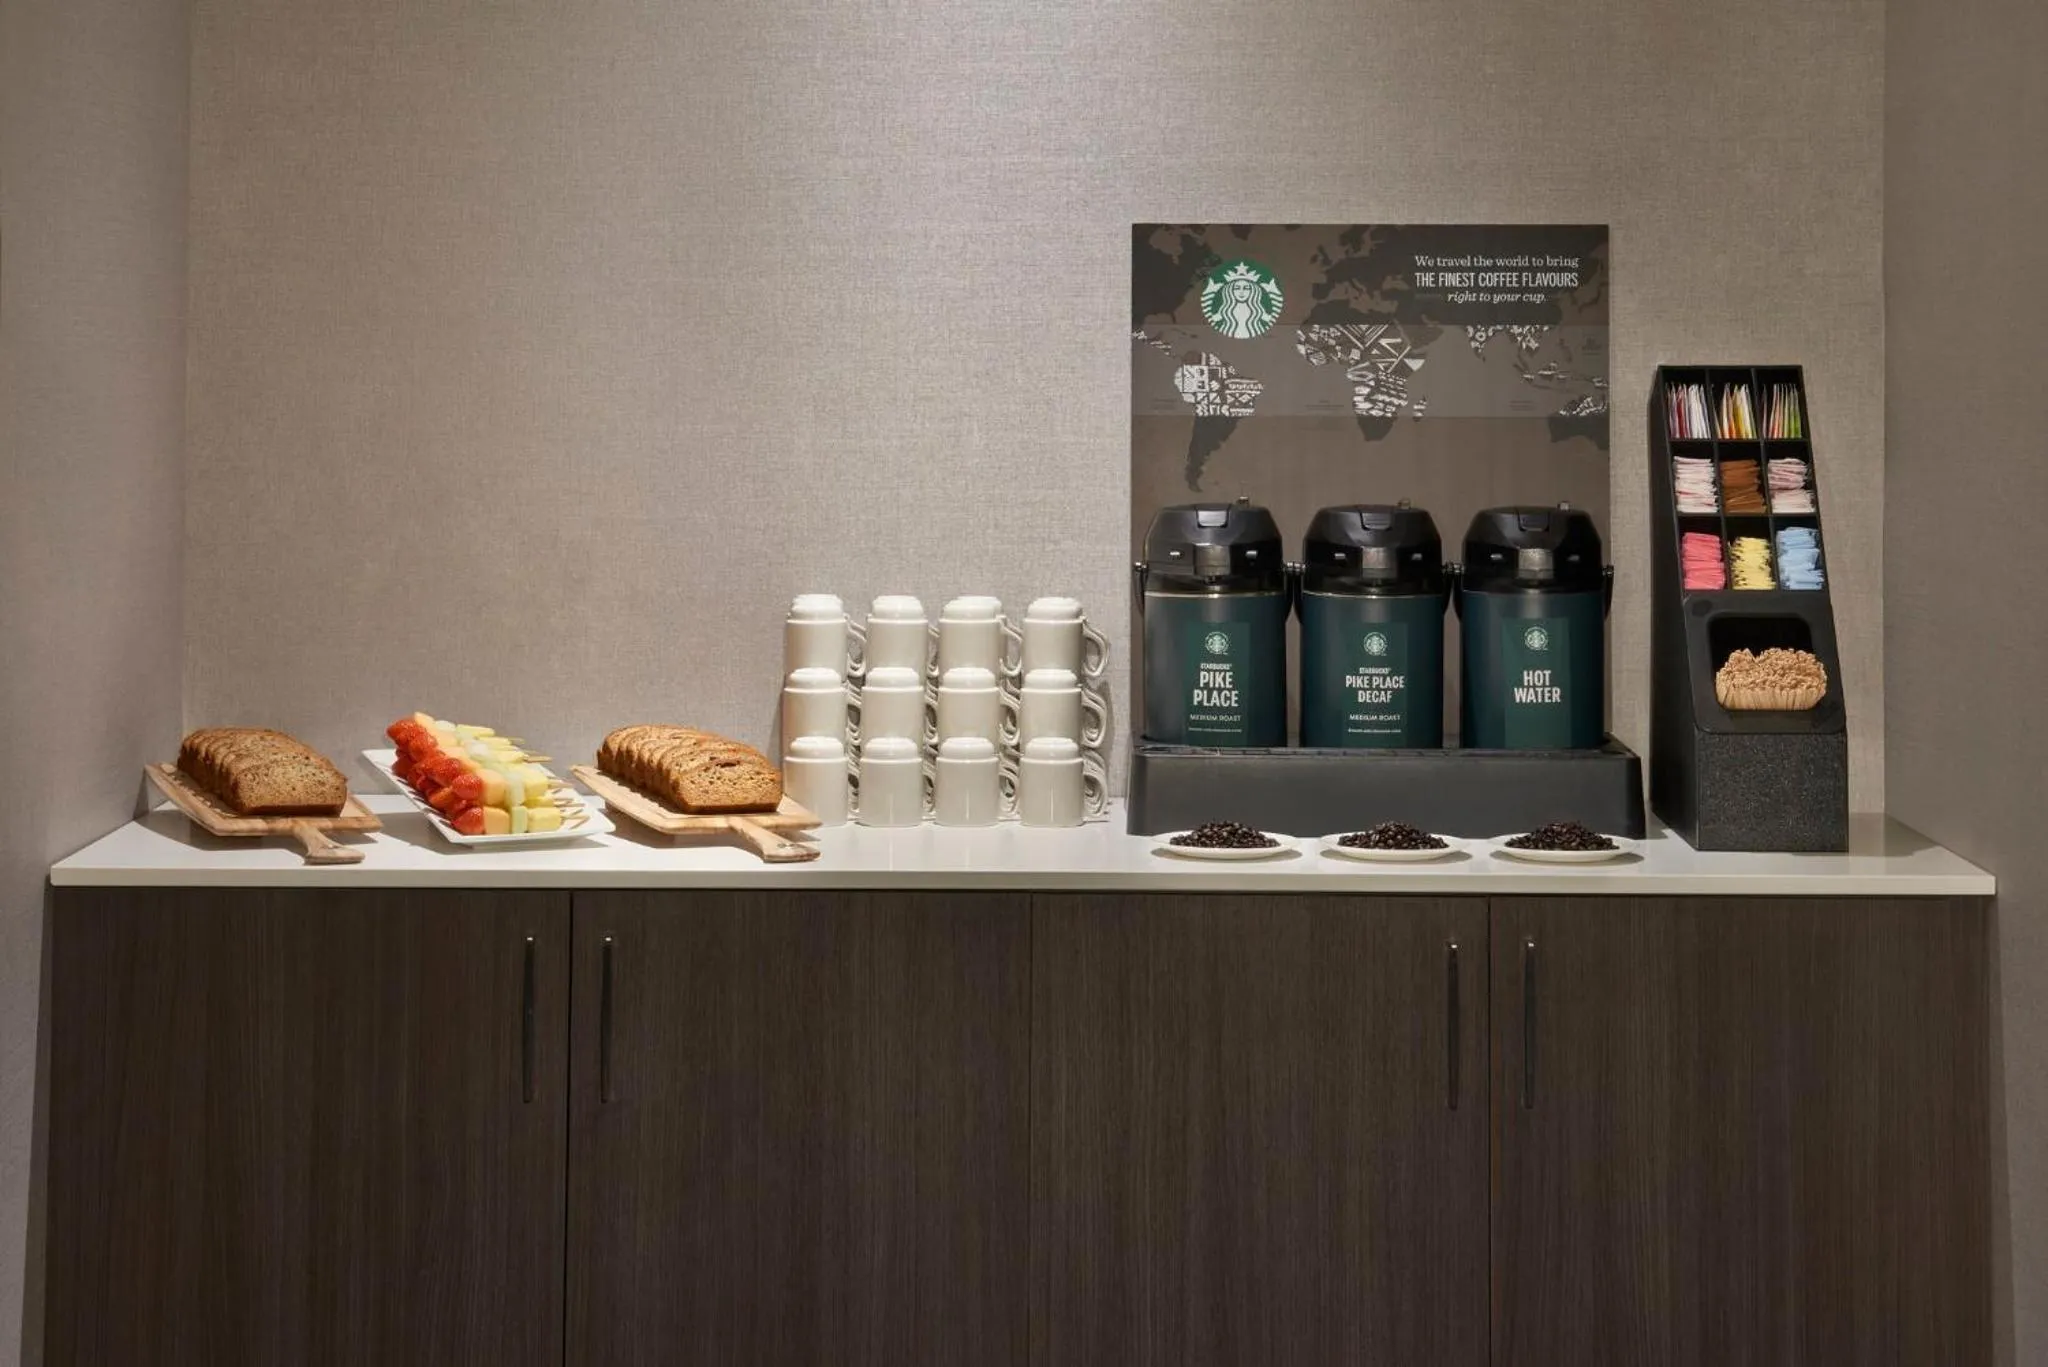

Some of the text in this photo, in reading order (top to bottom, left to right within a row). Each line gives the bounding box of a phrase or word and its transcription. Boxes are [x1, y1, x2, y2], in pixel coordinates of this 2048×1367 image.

[1415, 255, 1579, 269] We travel the world to bring
[1415, 272, 1579, 288] THE FINEST COFFEE FLAVOURS
[1447, 291, 1477, 304] right
[1479, 292, 1491, 303] to
[1492, 294, 1521, 304] your
[1199, 671, 1233, 688] PIKE
[1345, 675, 1405, 689] PIKE PLACE
[1523, 670, 1552, 686] HOT
[1193, 689, 1239, 707] PLACE
[1357, 690, 1393, 703] DECAF
[1514, 687, 1561, 703] WATER
[1190, 713, 1241, 722] MEDIUM ROAST
